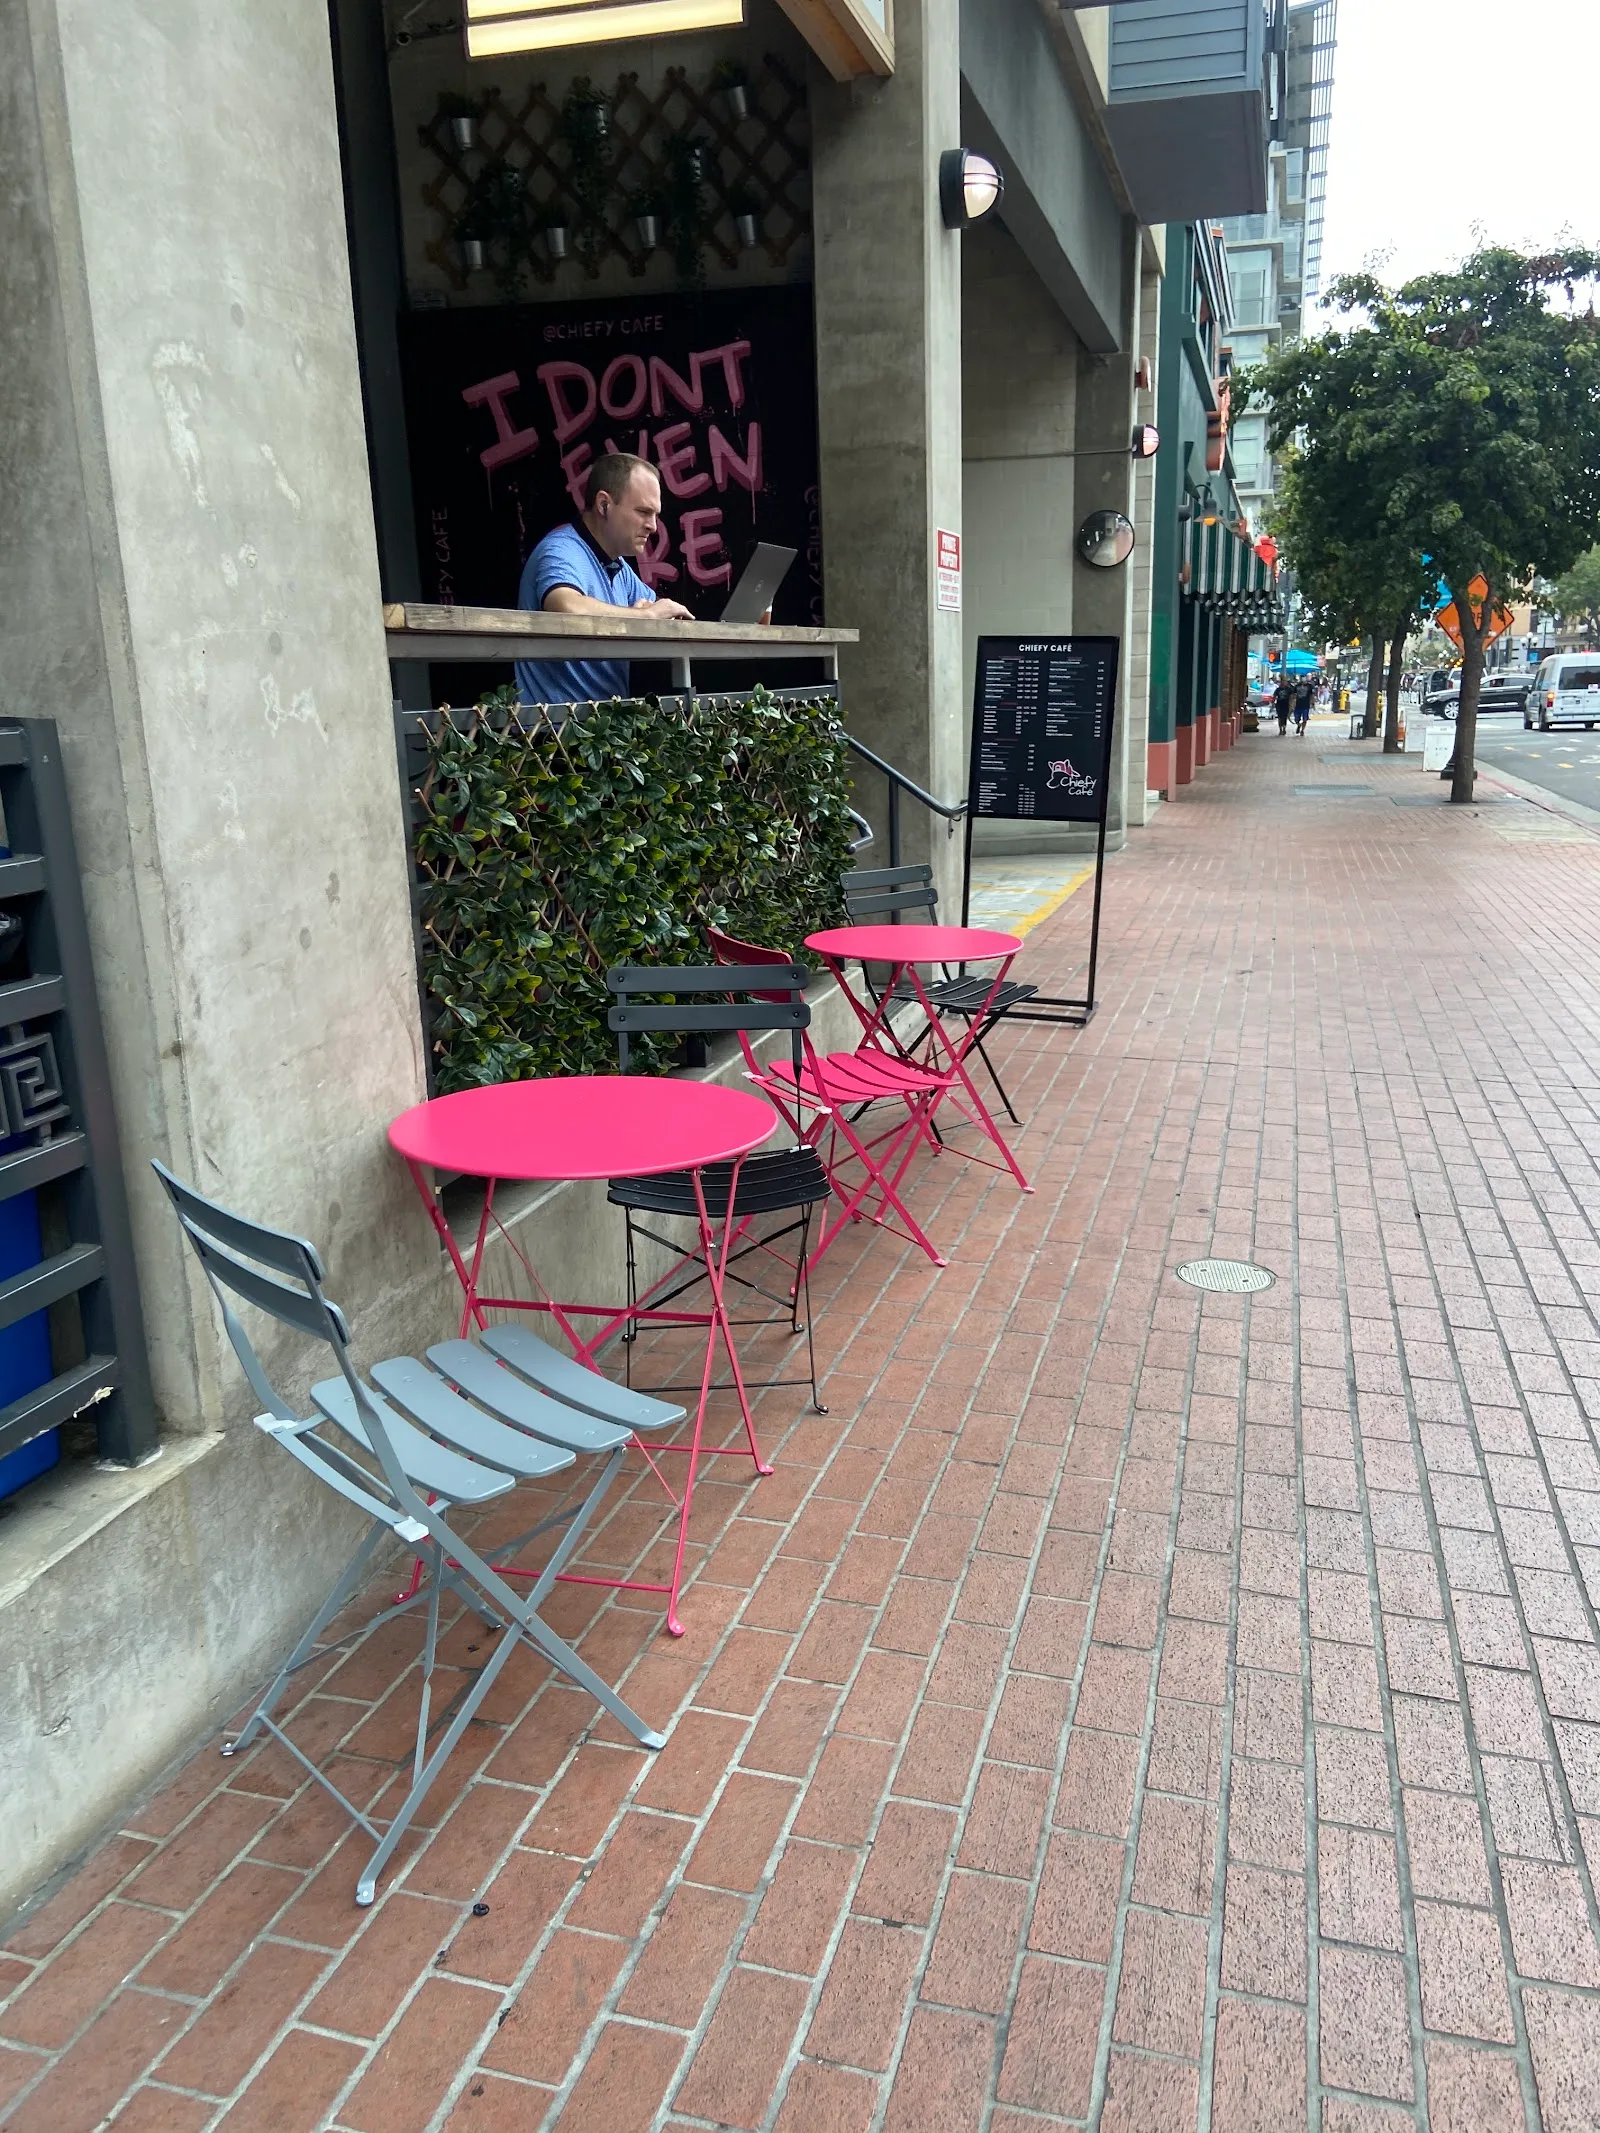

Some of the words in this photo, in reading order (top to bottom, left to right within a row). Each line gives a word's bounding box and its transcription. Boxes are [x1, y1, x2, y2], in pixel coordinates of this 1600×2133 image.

[542, 321, 615, 342] @CHIEFY
[620, 315, 665, 337] CAFE
[462, 370, 540, 469] I
[536, 340, 751, 444] DONT
[1018, 644, 1048, 652] CHIEFY
[1060, 775, 1097, 789] Chiefy
